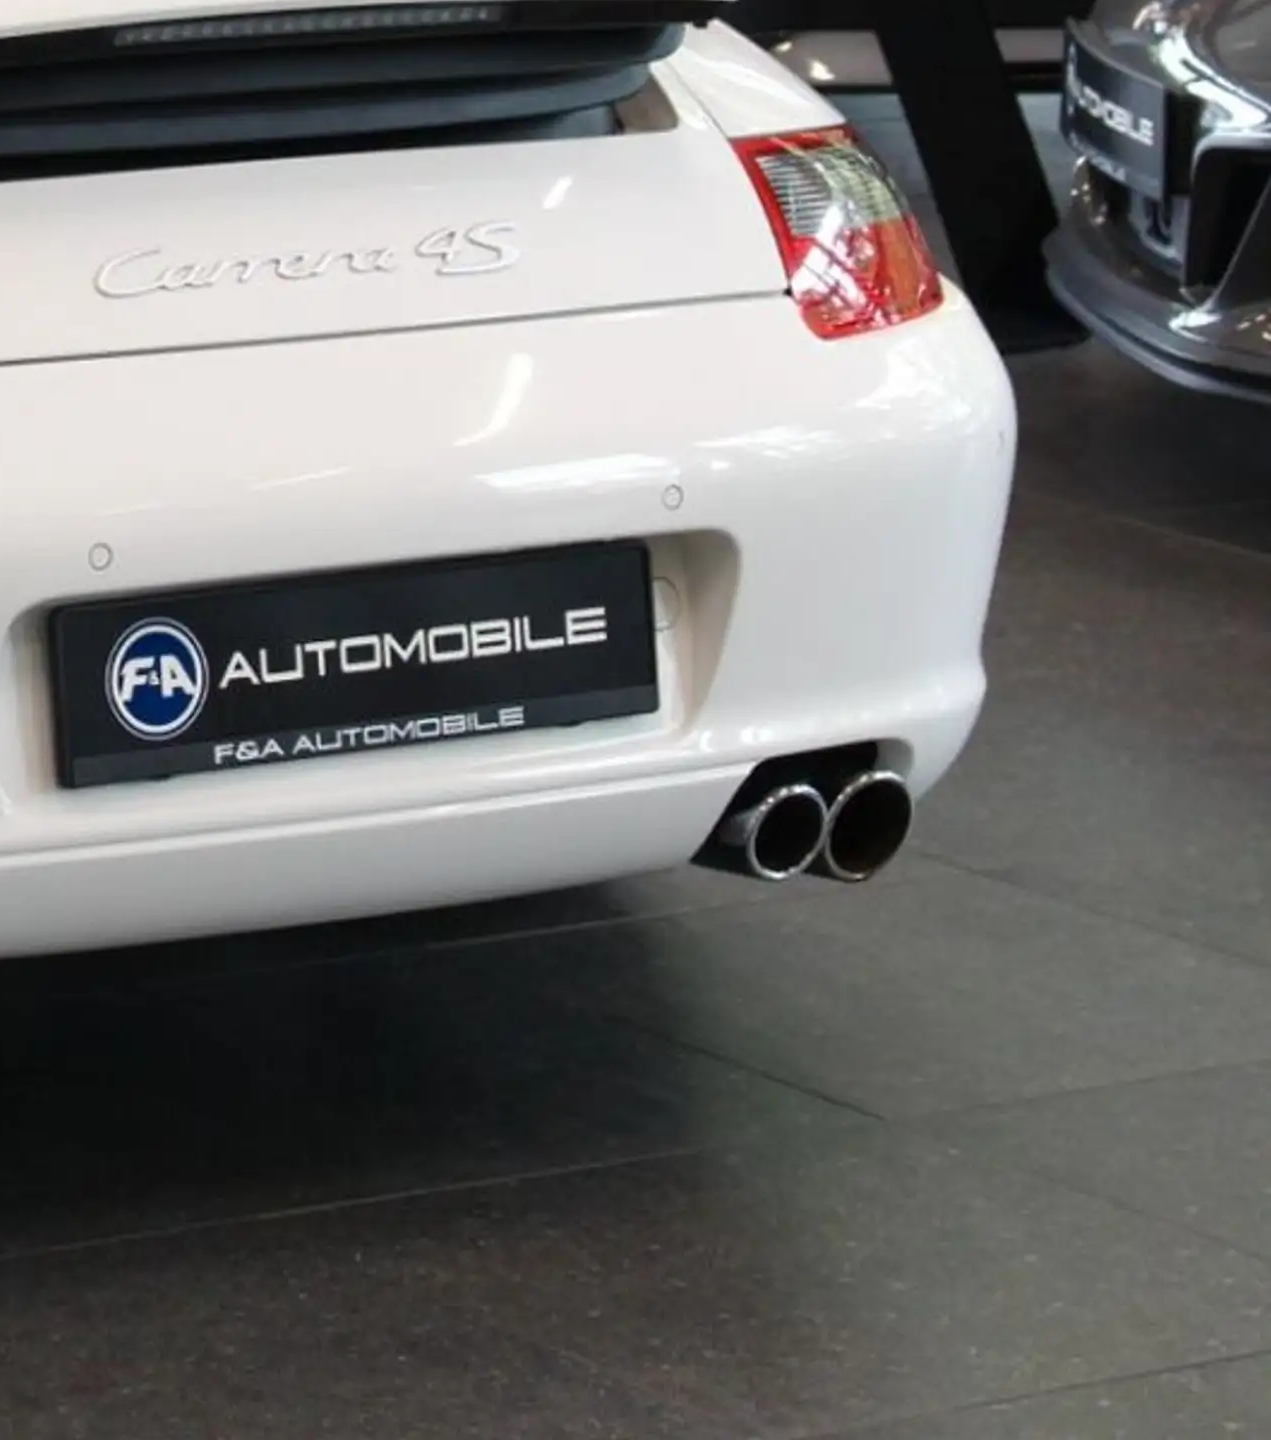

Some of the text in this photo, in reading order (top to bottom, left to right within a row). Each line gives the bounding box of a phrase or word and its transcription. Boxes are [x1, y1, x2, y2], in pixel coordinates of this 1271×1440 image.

[94, 220, 522, 298] Carrera 4S
[120, 607, 608, 703] F&A AUTOMOBILE
[214, 706, 525, 765] F&A AUTOMOBILE
